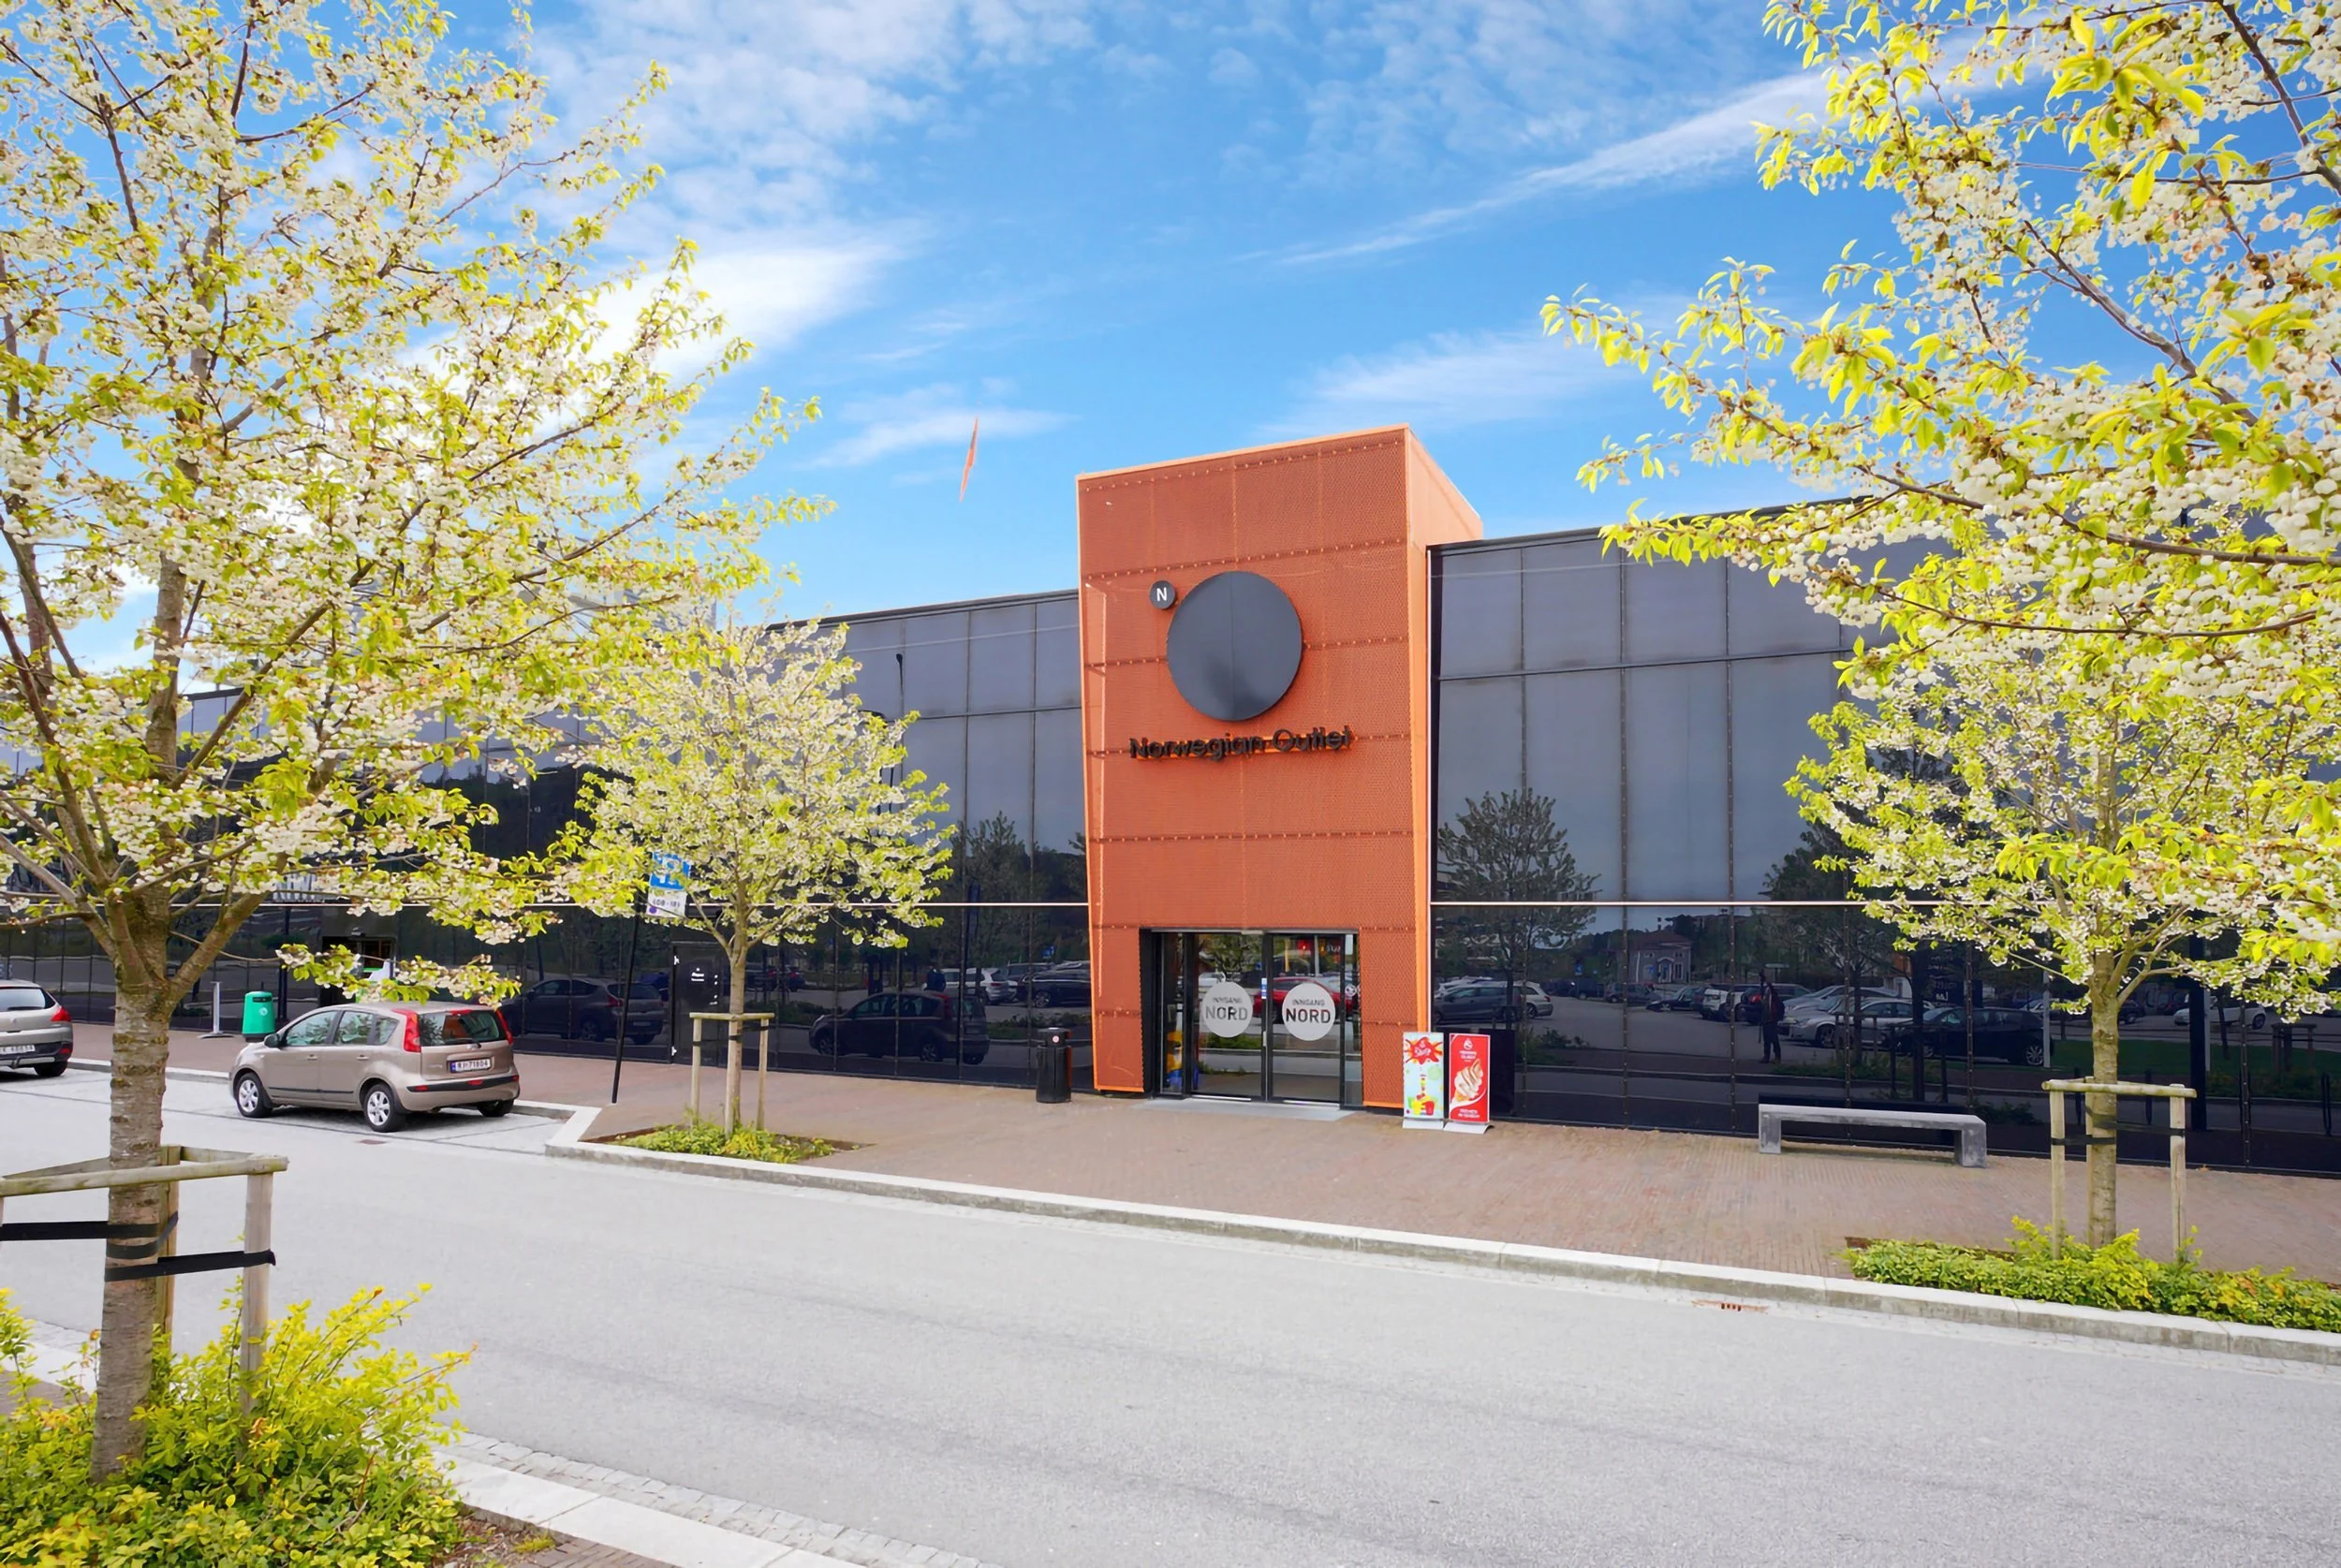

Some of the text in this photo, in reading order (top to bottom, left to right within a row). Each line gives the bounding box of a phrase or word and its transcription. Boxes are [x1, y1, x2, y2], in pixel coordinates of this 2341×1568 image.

[1156, 587, 1167, 602] N
[1129, 725, 1352, 761] Norwegian Outlet
[1205, 1006, 1248, 1021] NORD
[1286, 1008, 1331, 1023] NORD
